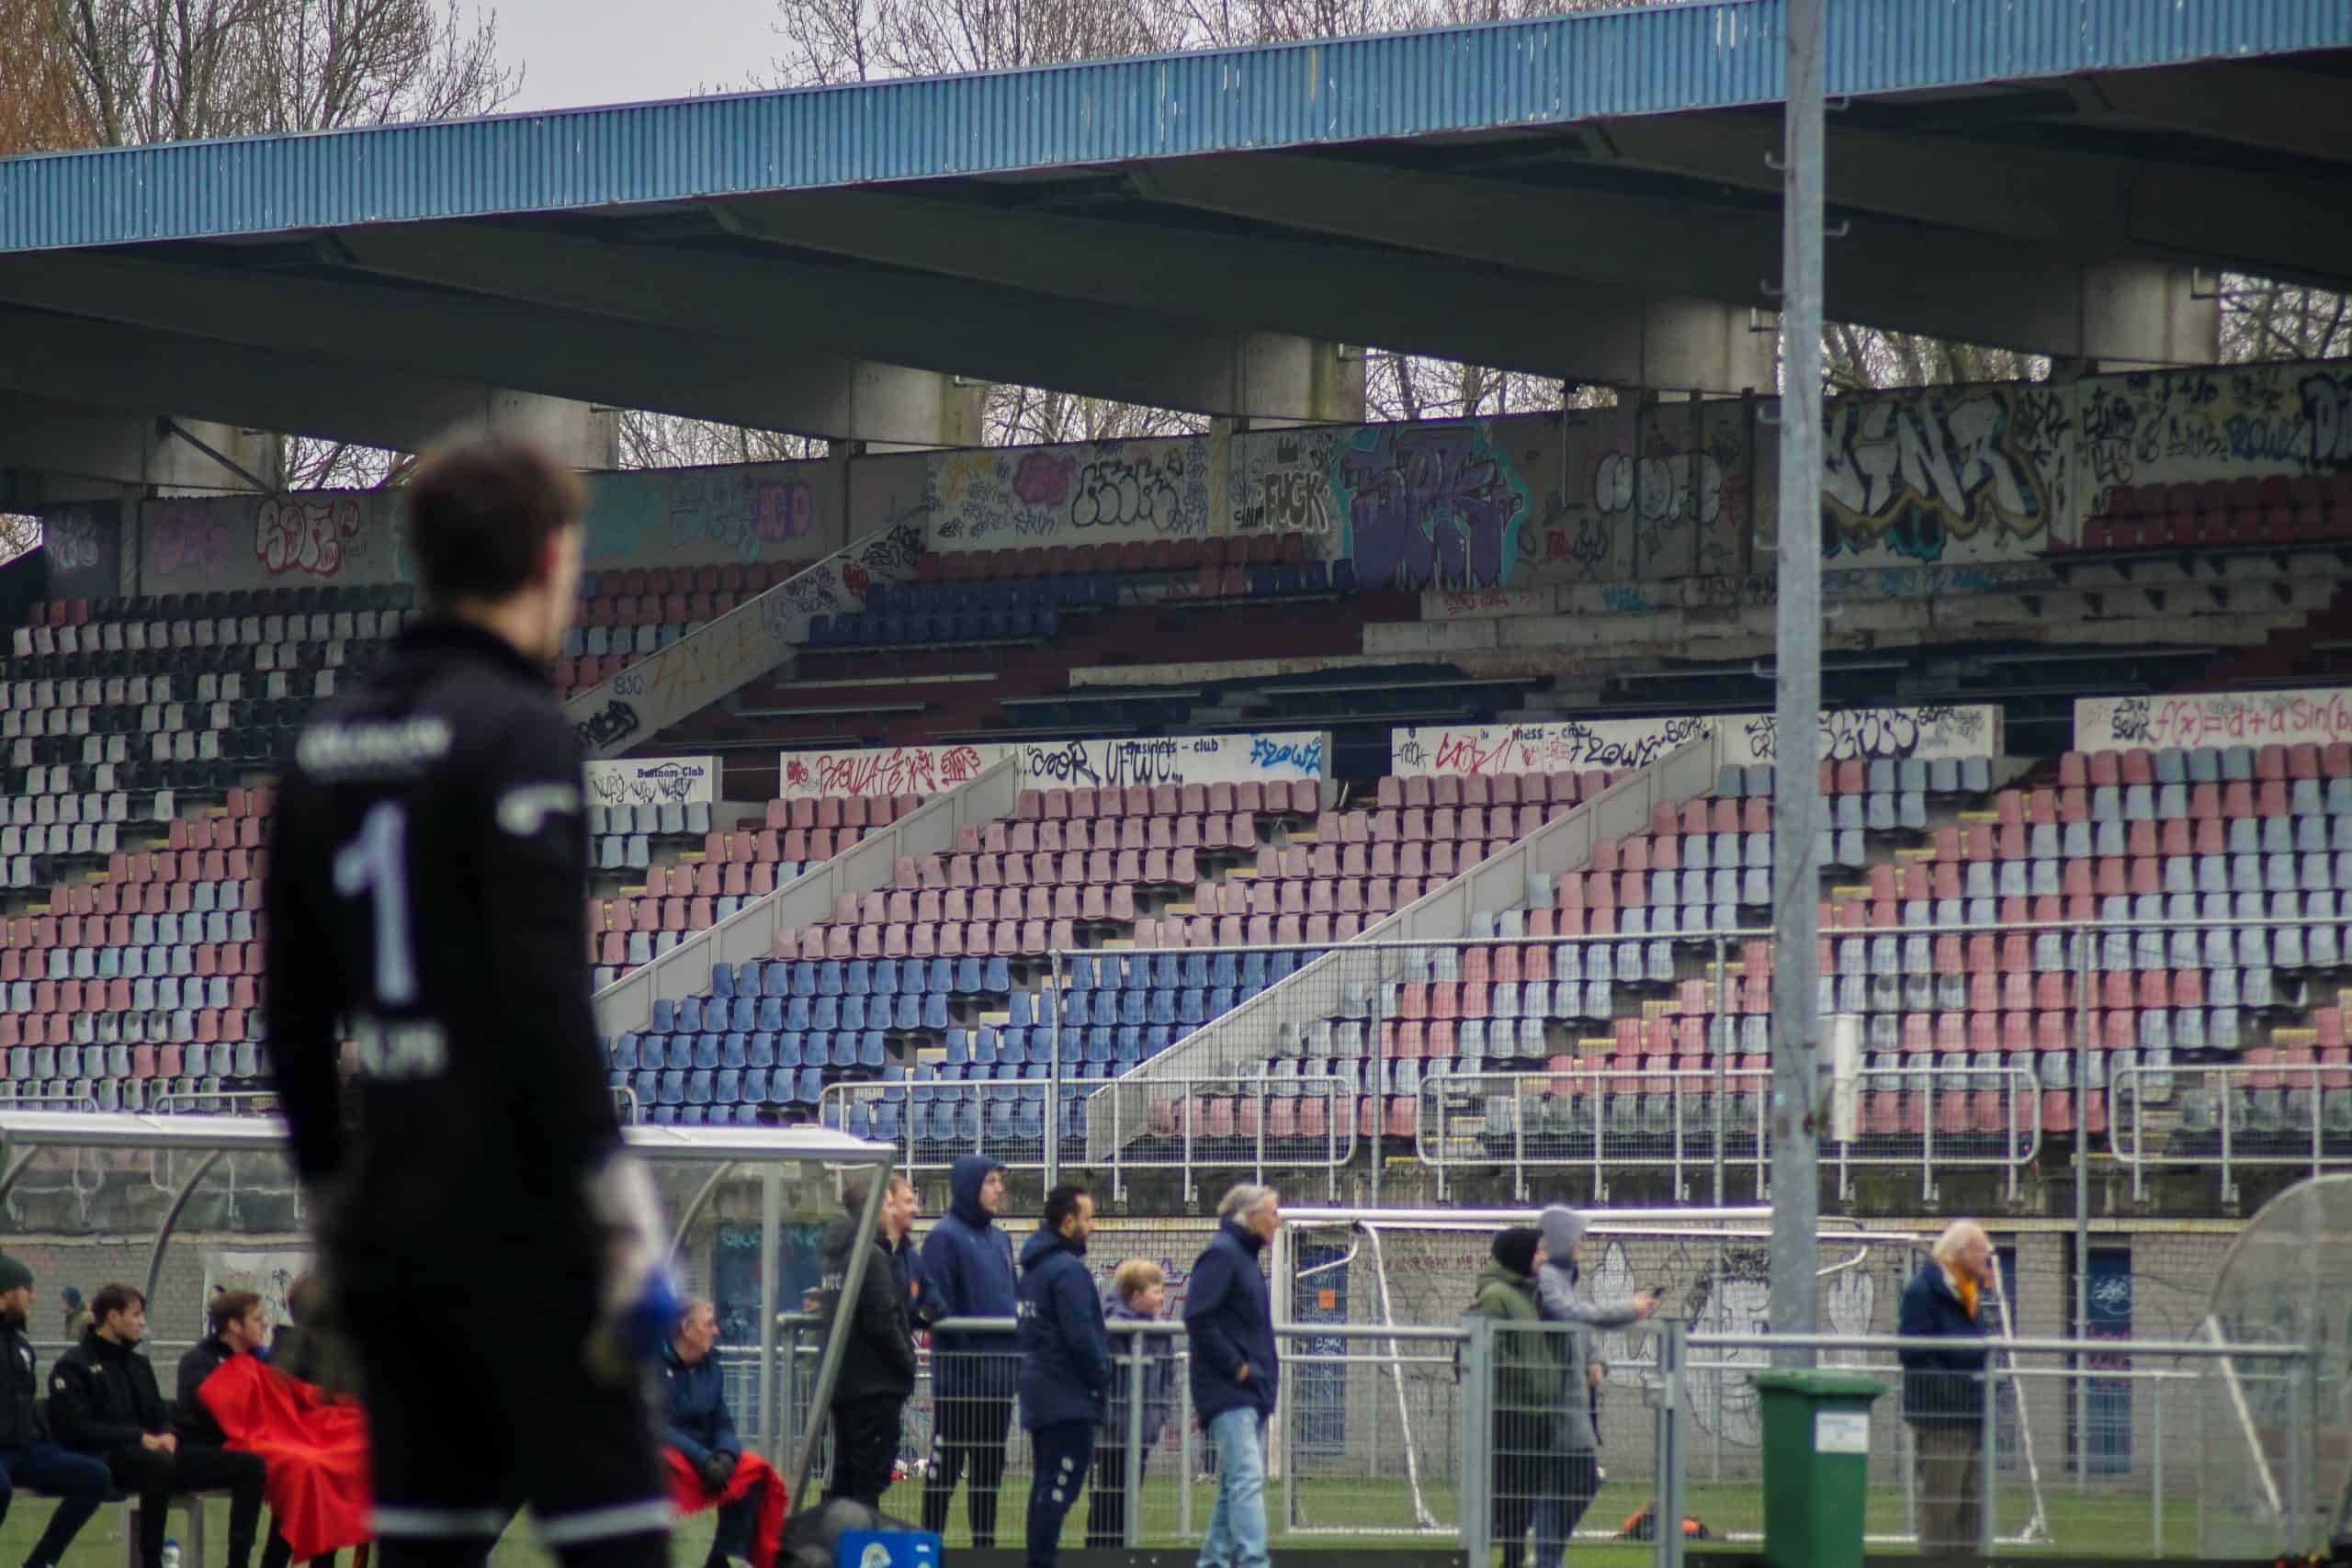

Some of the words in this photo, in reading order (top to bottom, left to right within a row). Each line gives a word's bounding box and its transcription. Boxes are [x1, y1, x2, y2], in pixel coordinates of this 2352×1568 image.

[1193, 738, 1219, 752] club
[682, 764, 705, 777] Club
[333, 799, 417, 1004] 1
